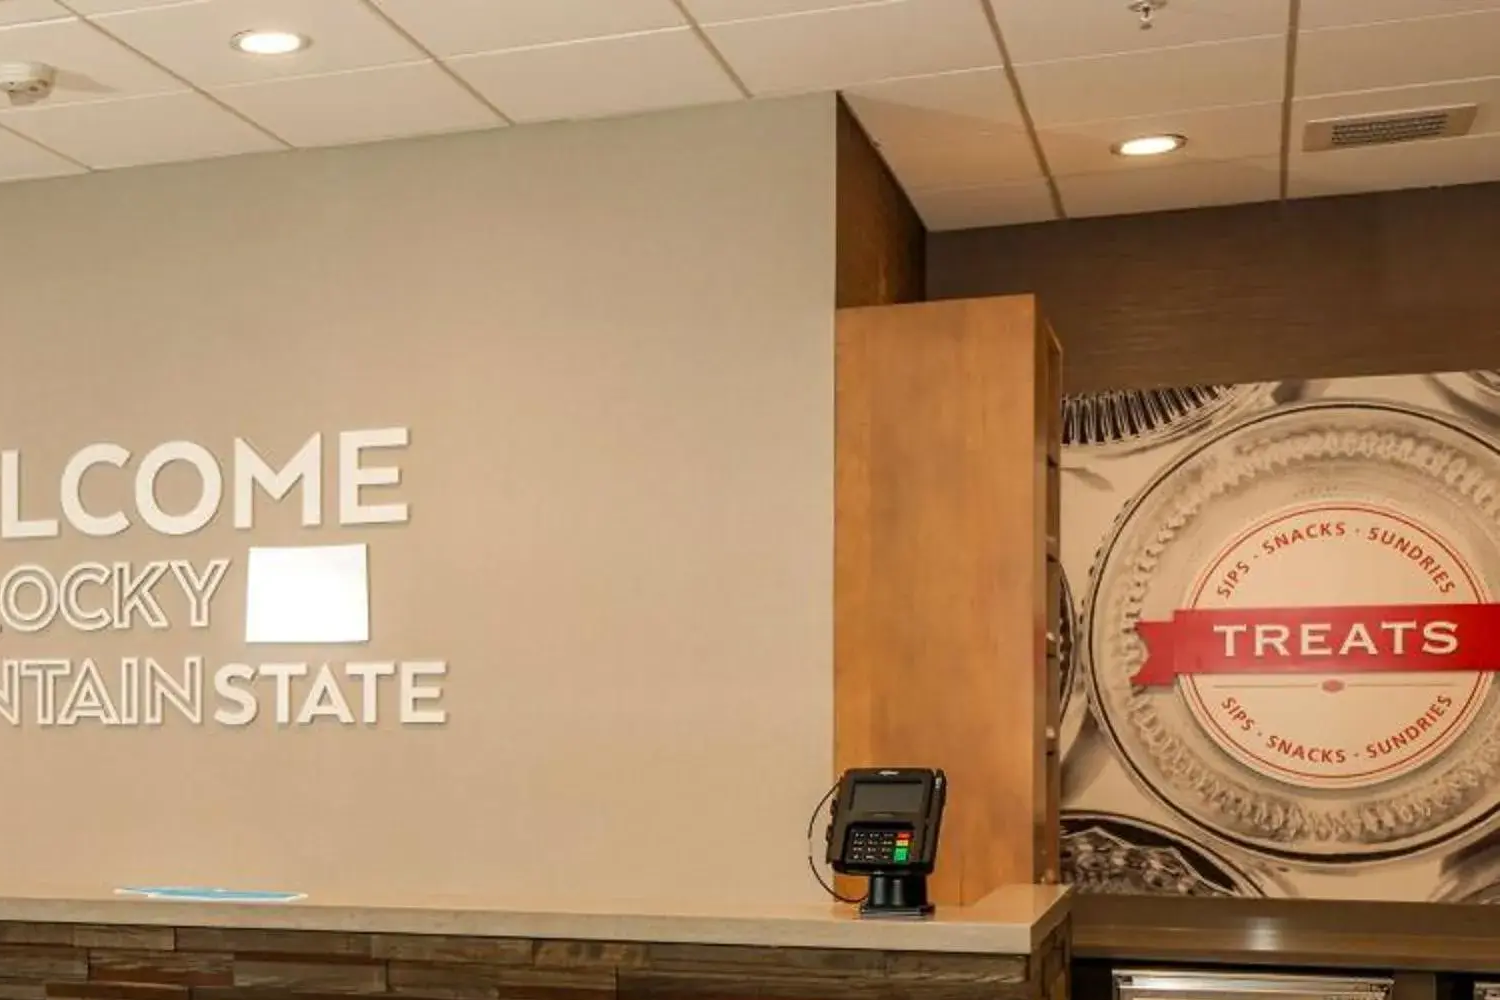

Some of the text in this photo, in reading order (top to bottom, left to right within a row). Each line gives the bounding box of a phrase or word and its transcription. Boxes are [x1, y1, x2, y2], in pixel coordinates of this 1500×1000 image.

[1217, 521, 1456, 599] SIPS SNACKS SUNDRIES
[1213, 620, 1459, 657] TREATS
[213, 659, 448, 727] STATE
[1221, 695, 1452, 763] SIPS SNACKS SUNDRIES
